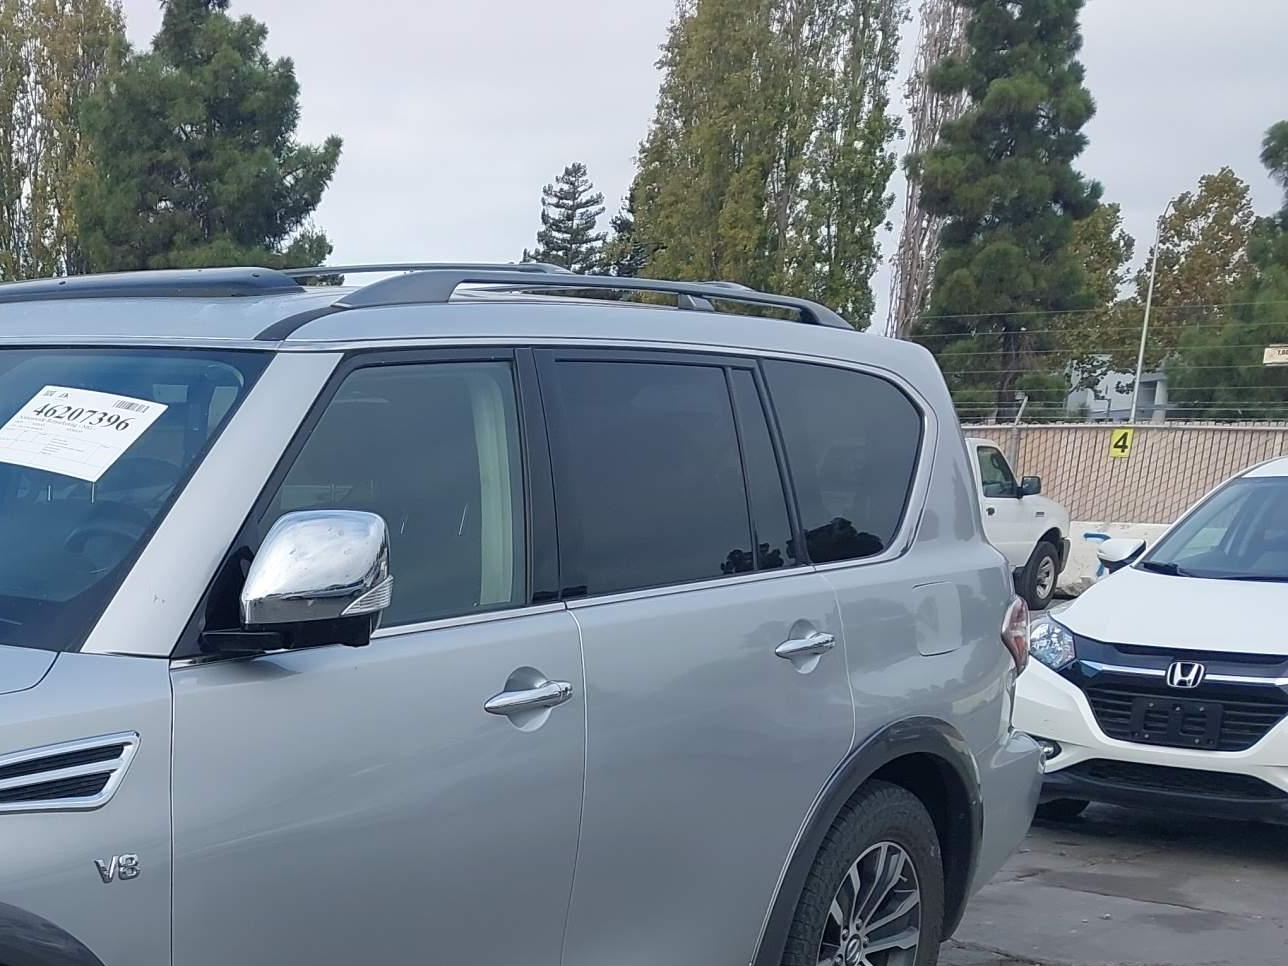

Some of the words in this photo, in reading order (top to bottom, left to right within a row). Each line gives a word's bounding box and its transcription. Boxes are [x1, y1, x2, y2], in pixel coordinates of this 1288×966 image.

[33, 402, 135, 432] 46207396
[1113, 431, 1129, 454] 4
[94, 853, 141, 884] V8
